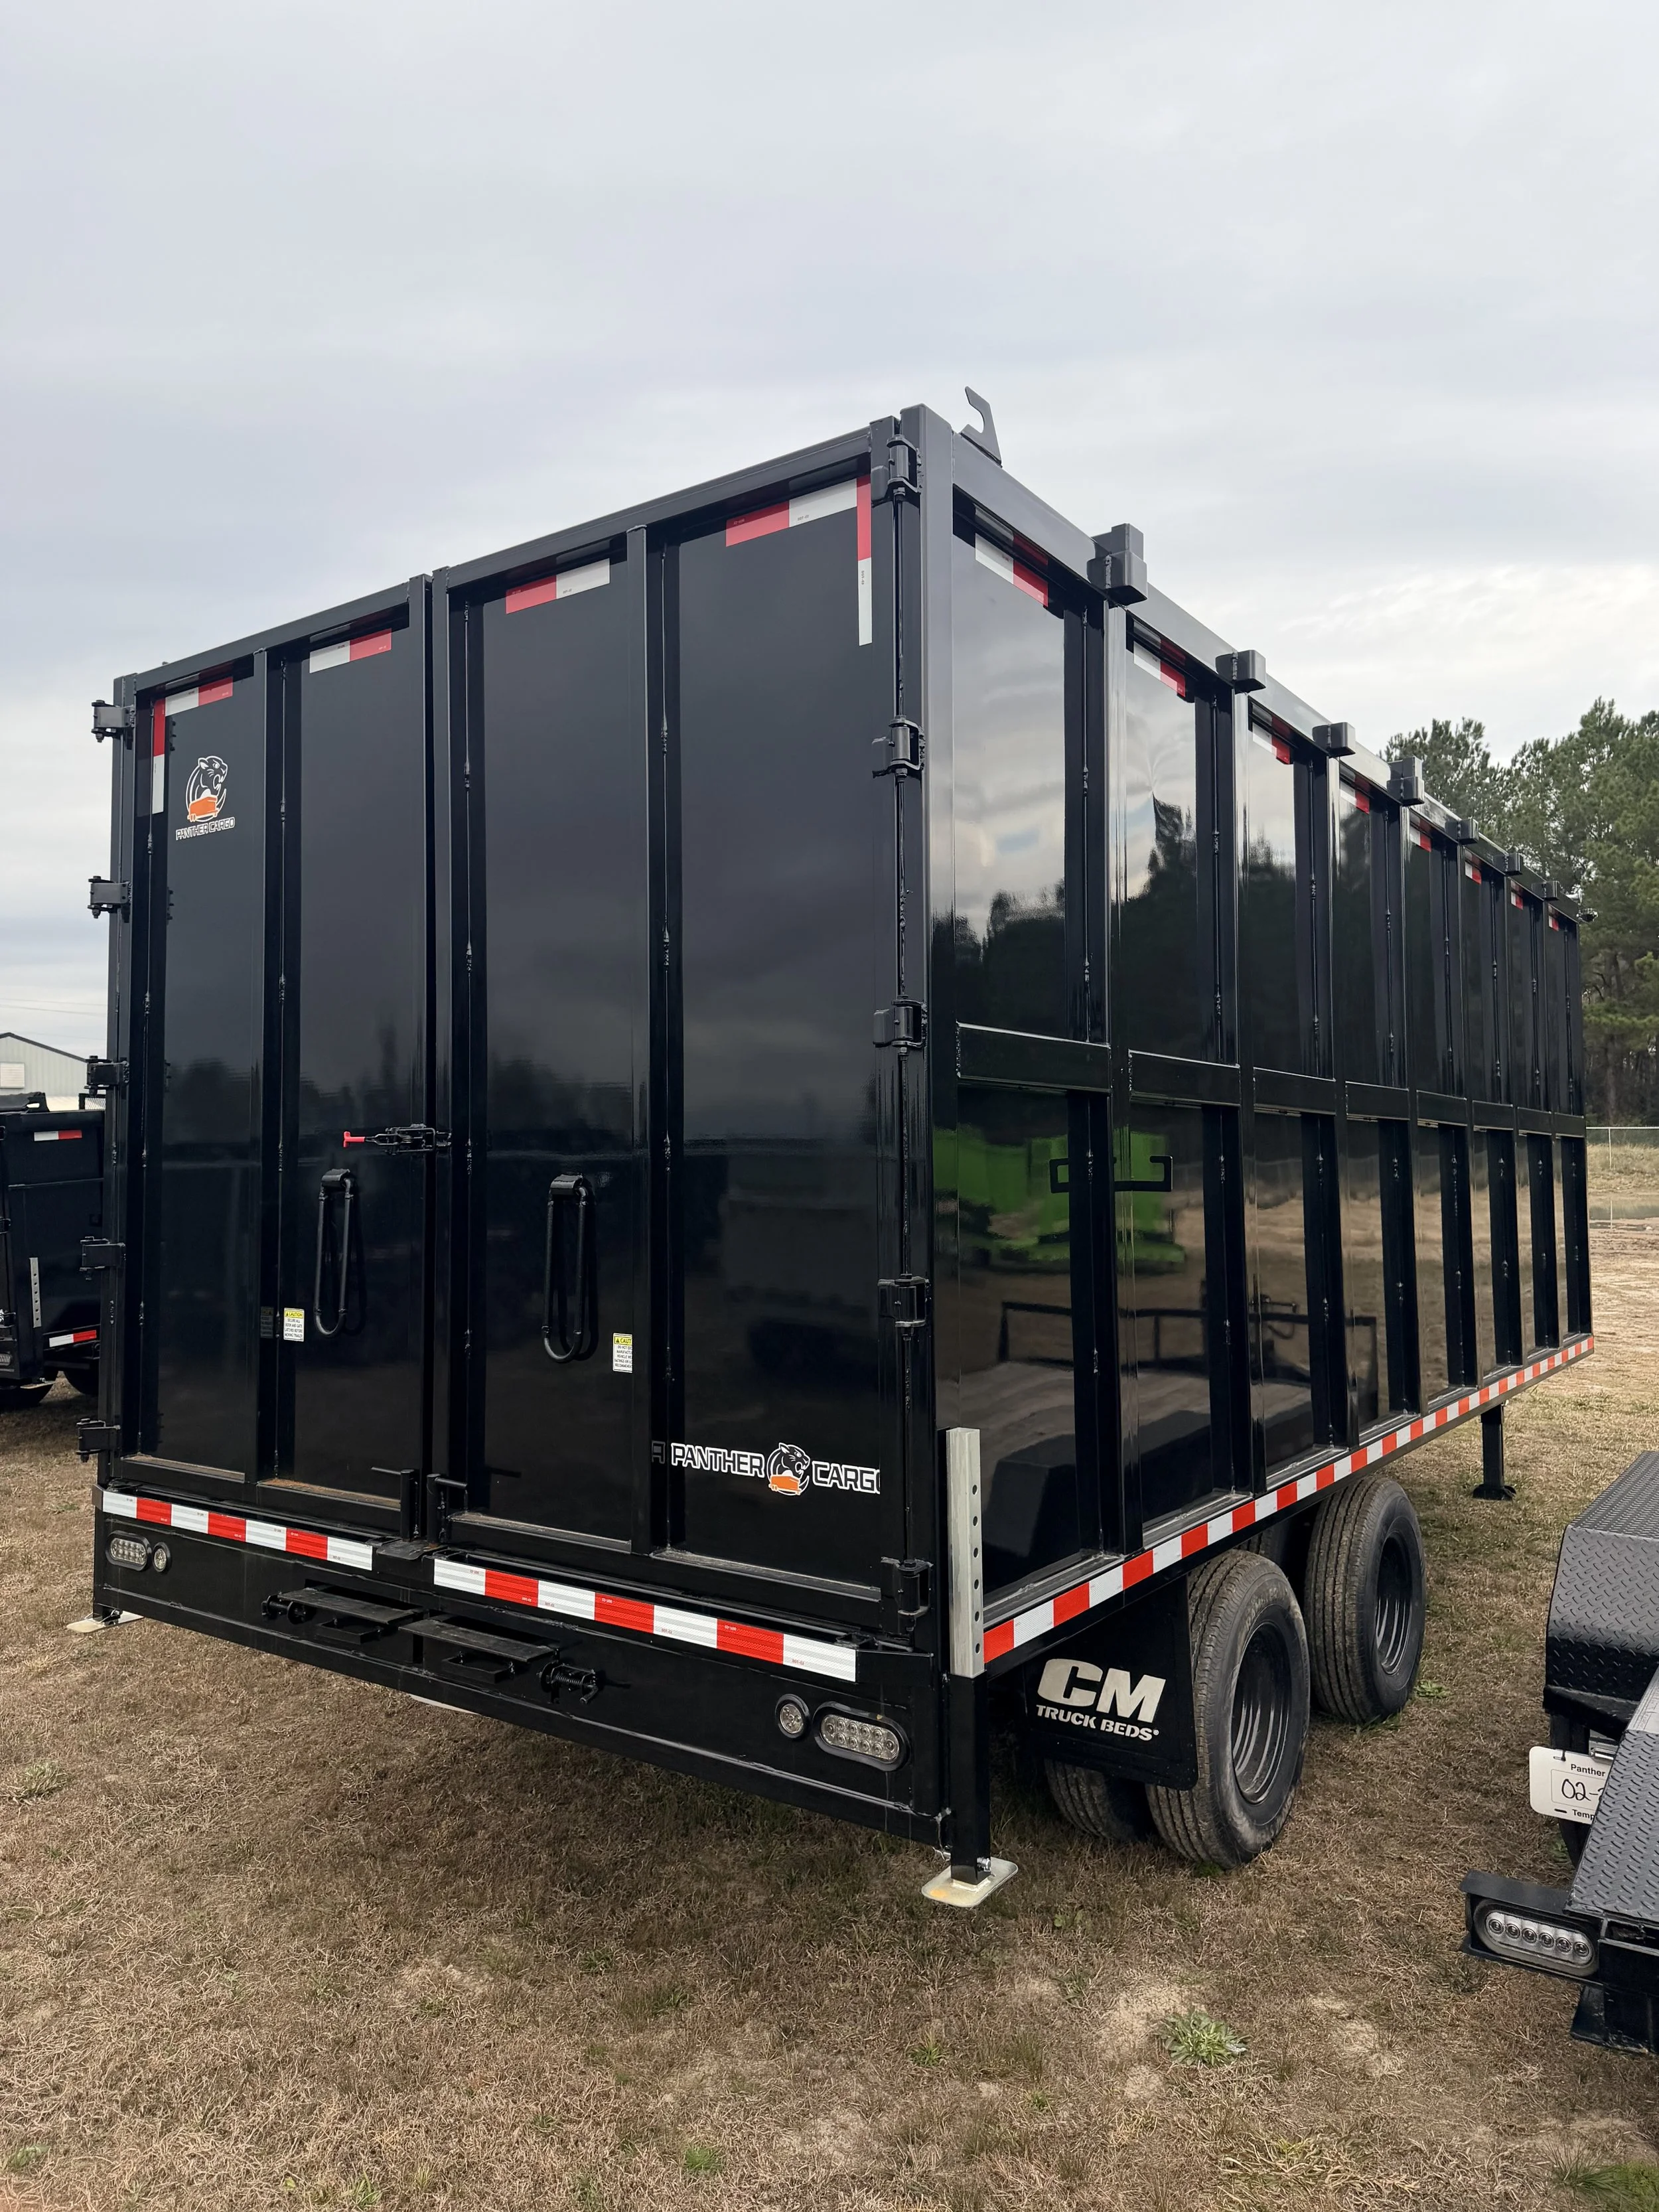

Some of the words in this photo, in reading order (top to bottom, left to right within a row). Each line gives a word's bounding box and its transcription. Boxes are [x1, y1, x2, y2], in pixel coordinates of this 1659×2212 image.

[176, 822, 208, 841] PANTHER
[208, 816, 236, 834] CARGO
[670, 1442, 765, 1478] PANTHER
[812, 1461, 881, 1495] CARG
[1037, 1658, 1167, 1724] CM
[1036, 1704, 1097, 1729] TRUCK
[1570, 1763, 1606, 1777] Panther
